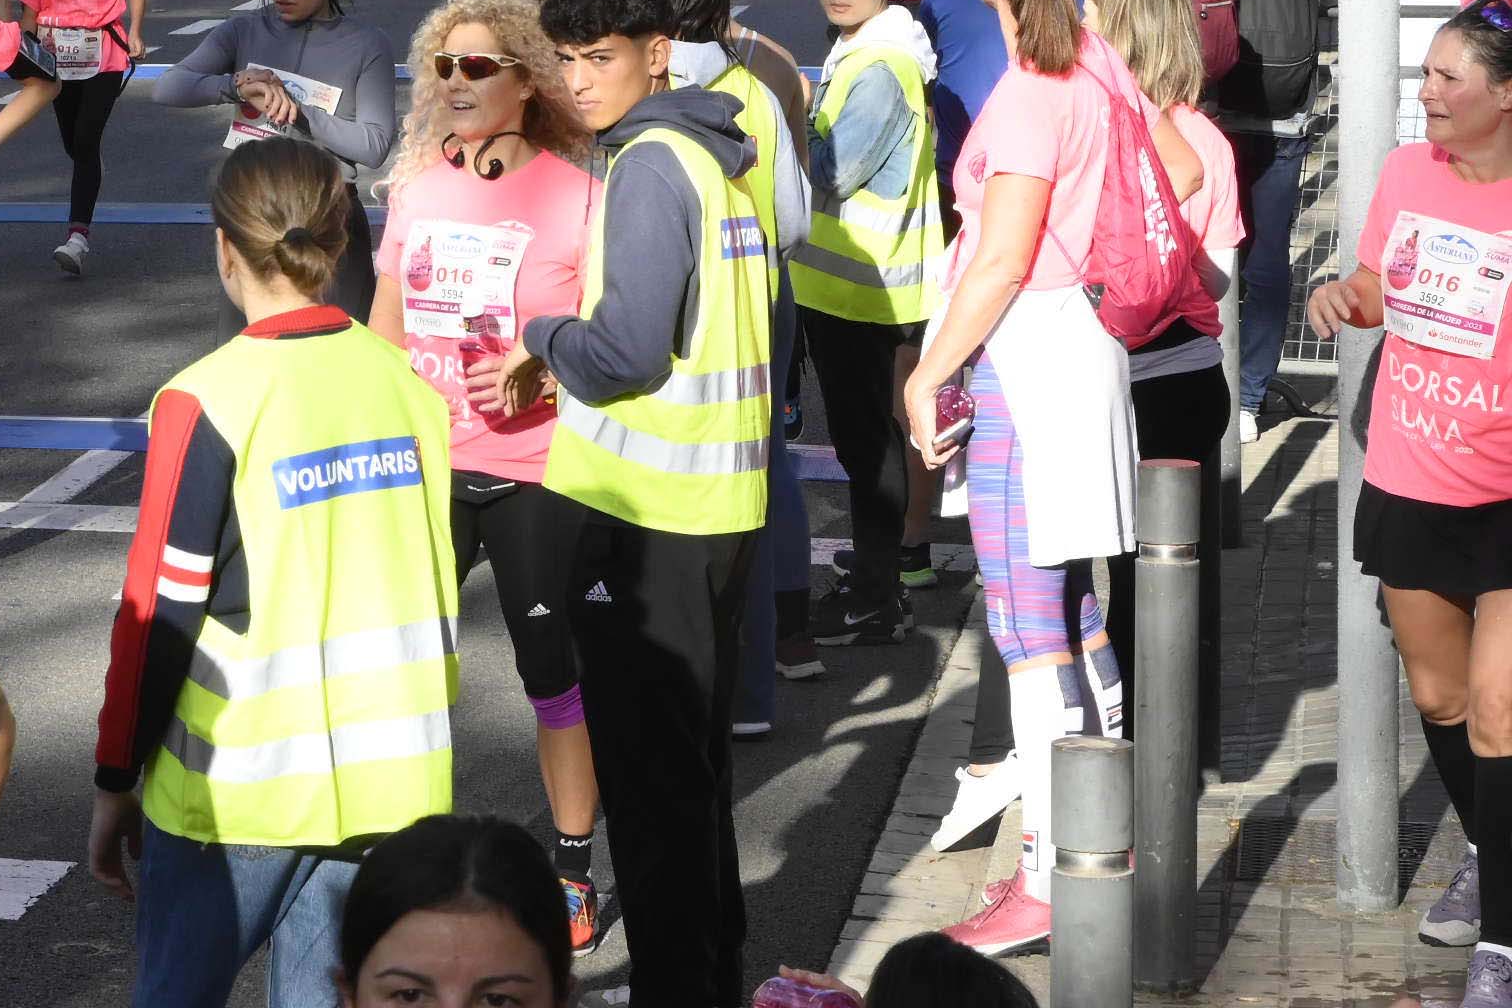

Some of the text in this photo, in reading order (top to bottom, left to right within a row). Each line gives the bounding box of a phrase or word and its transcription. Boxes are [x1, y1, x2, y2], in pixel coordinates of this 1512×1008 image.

[436, 267, 473, 285] 016
[1418, 269, 1461, 292] 016
[1419, 291, 1445, 307] 3592
[1390, 300, 1417, 313] CARRERA
[1435, 312, 1462, 325] MUJER
[1439, 331, 1483, 349] Santander
[1389, 352, 1504, 412] DORSAL
[279, 449, 418, 495] VOLUNTARIS
[585, 594, 612, 602] adidas
